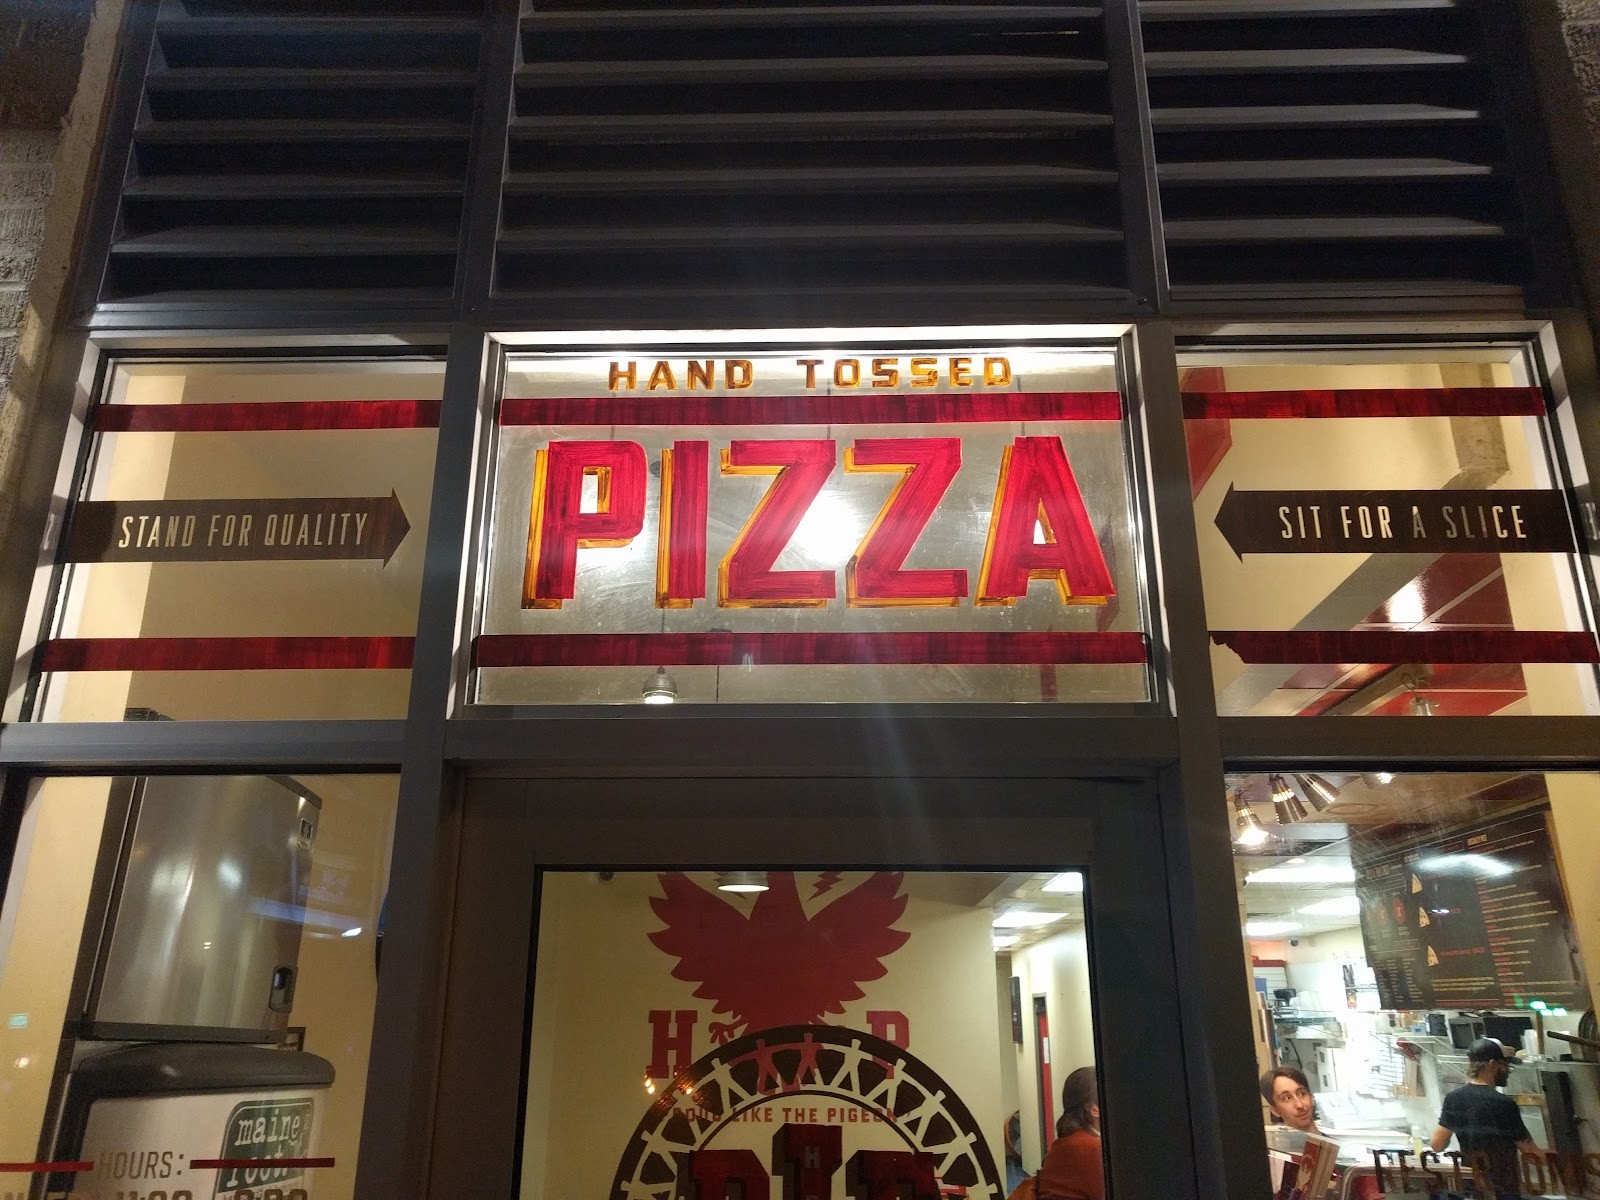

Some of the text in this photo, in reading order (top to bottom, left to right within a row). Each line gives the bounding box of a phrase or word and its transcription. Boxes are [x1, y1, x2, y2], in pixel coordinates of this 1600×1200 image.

[607, 357, 1014, 391] HAND TOSSED
[118, 512, 368, 549] STAND FOR QUALITY
[521, 436, 1116, 609] PIZZA
[1278, 505, 1527, 540] SIT FOR A SLICE
[234, 1108, 300, 1146] maine
[732, 1107, 773, 1123] LIKE
[782, 1107, 817, 1123] THE
[98, 1151, 184, 1180] HOURS:
